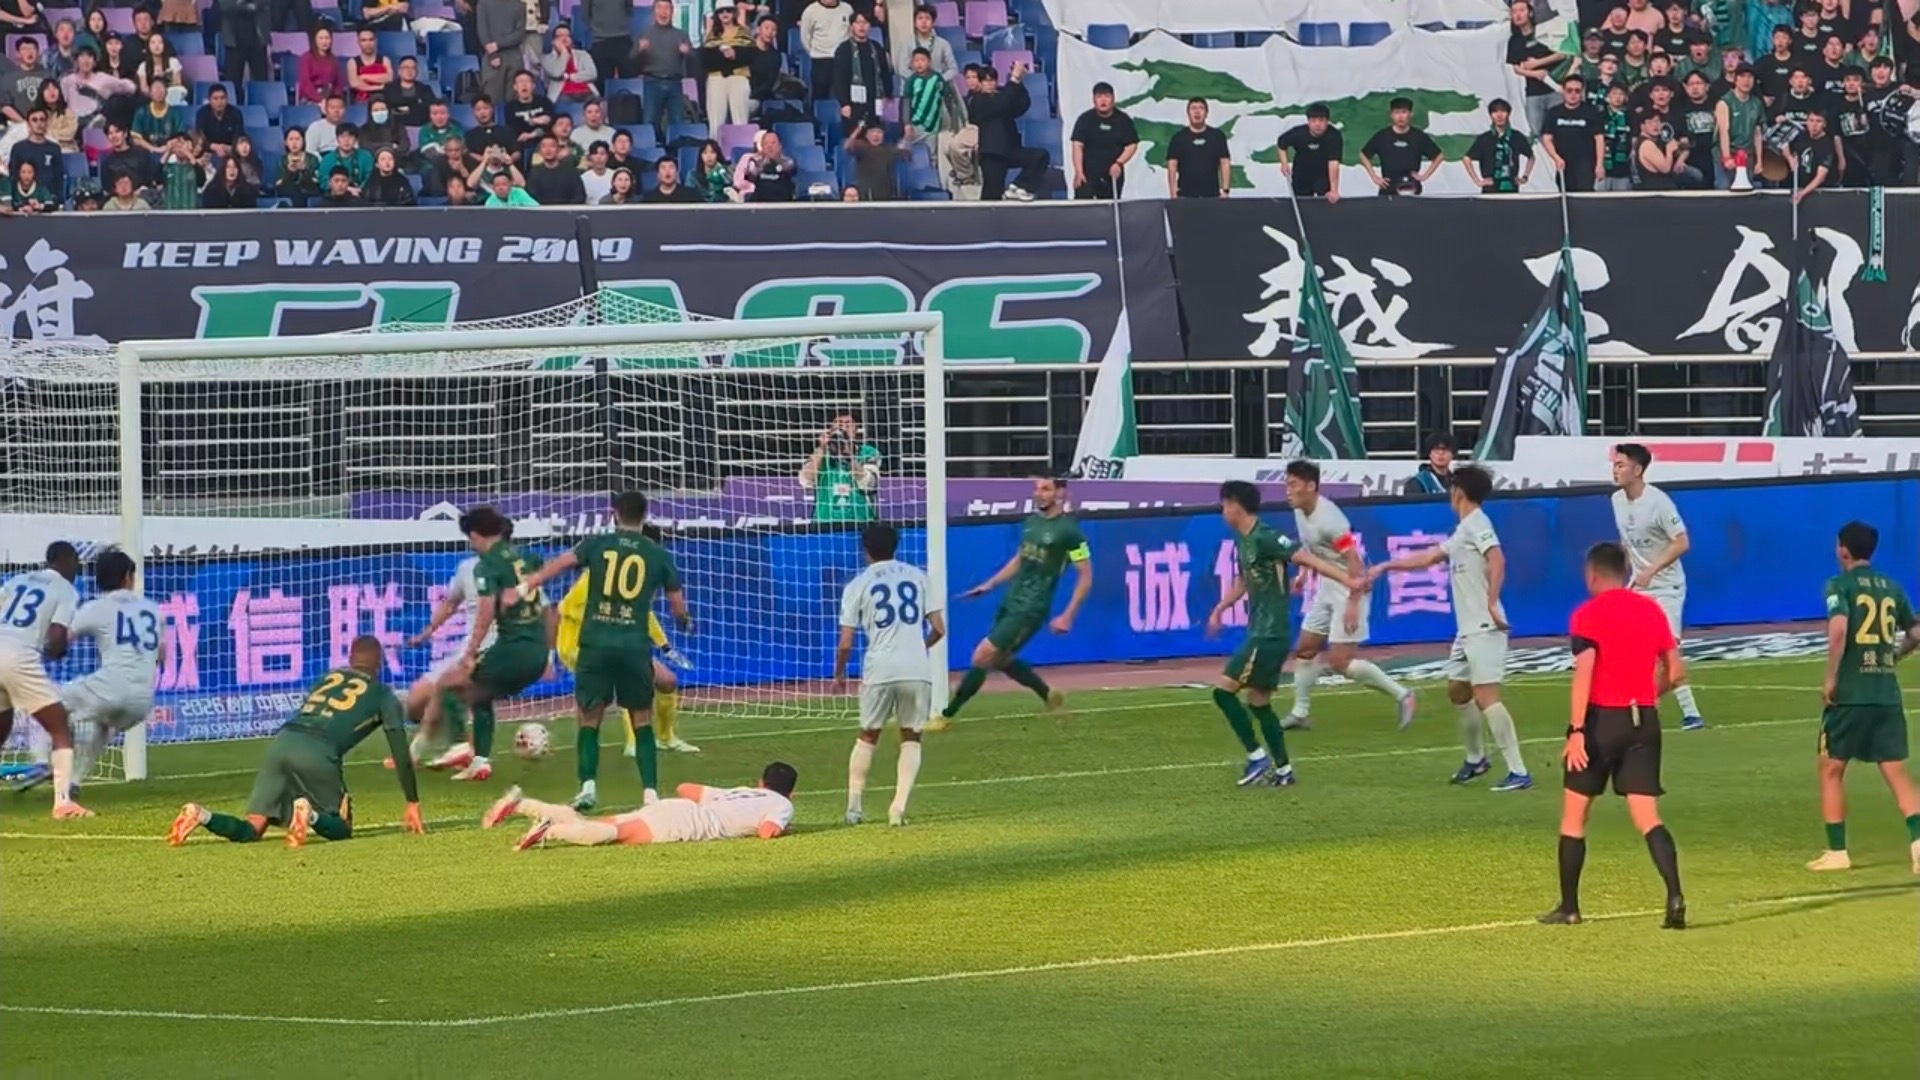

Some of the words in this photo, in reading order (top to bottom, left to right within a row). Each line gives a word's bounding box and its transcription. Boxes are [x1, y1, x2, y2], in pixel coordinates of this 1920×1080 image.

[122, 240, 260, 268] KEEP
[273, 237, 482, 265] WAVING
[496, 236, 633, 262] 2009
[602, 549, 647, 600] 10
[2, 584, 46, 628] 13
[869, 580, 920, 629] 38
[1855, 593, 1897, 645] 26
[116, 609, 159, 654] 43
[306, 671, 369, 711] 23
